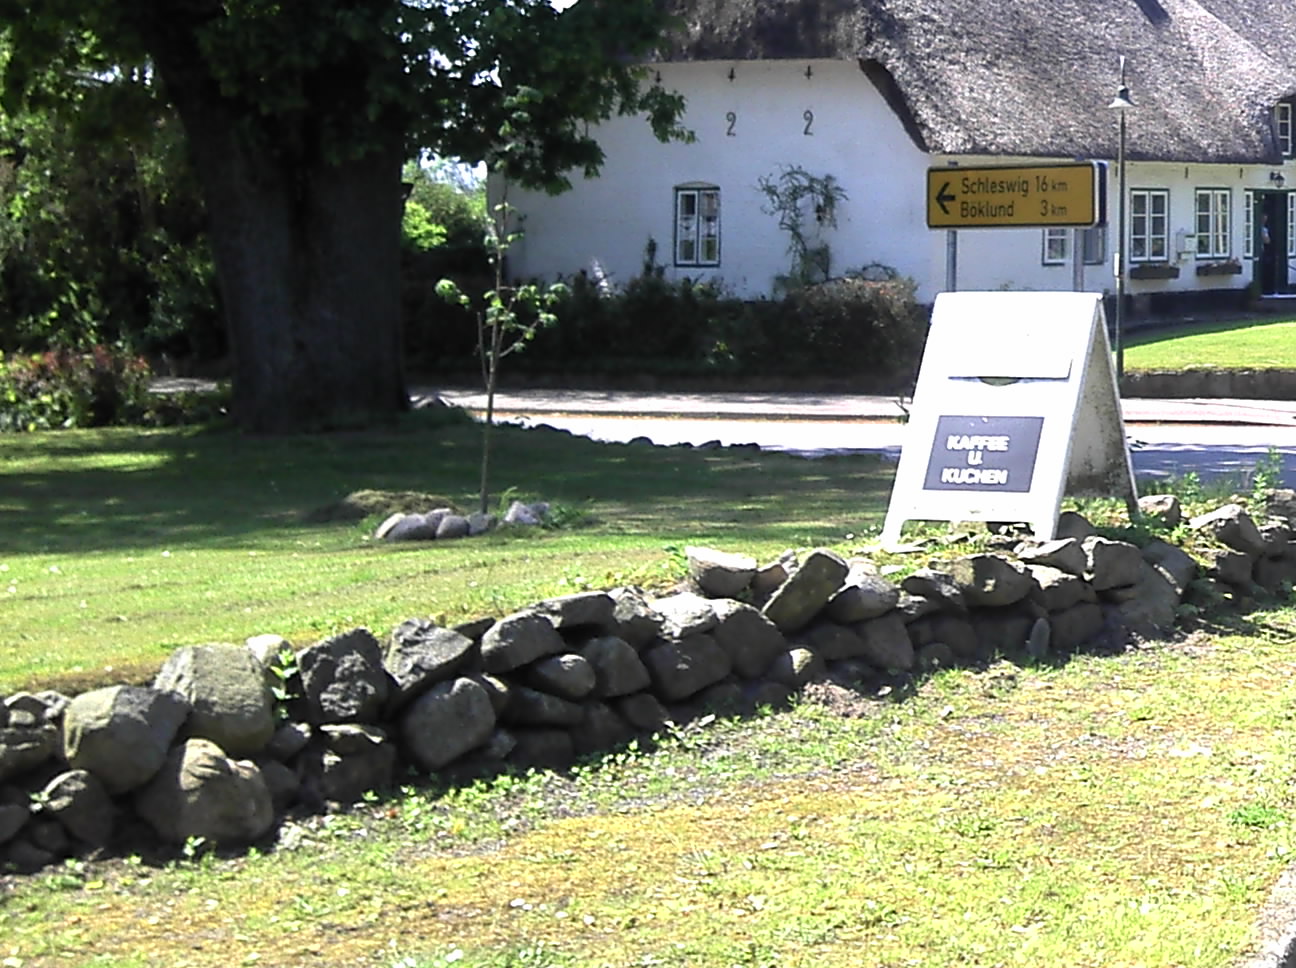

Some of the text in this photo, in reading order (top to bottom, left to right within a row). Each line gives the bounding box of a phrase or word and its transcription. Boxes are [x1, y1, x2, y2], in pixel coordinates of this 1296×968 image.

[961, 175, 1068, 197] Schleswig 16 km
[960, 200, 1068, 218] Böklund 3 km
[947, 435, 1010, 451] KAFFEE
[941, 468, 1008, 485] KUCHEN
